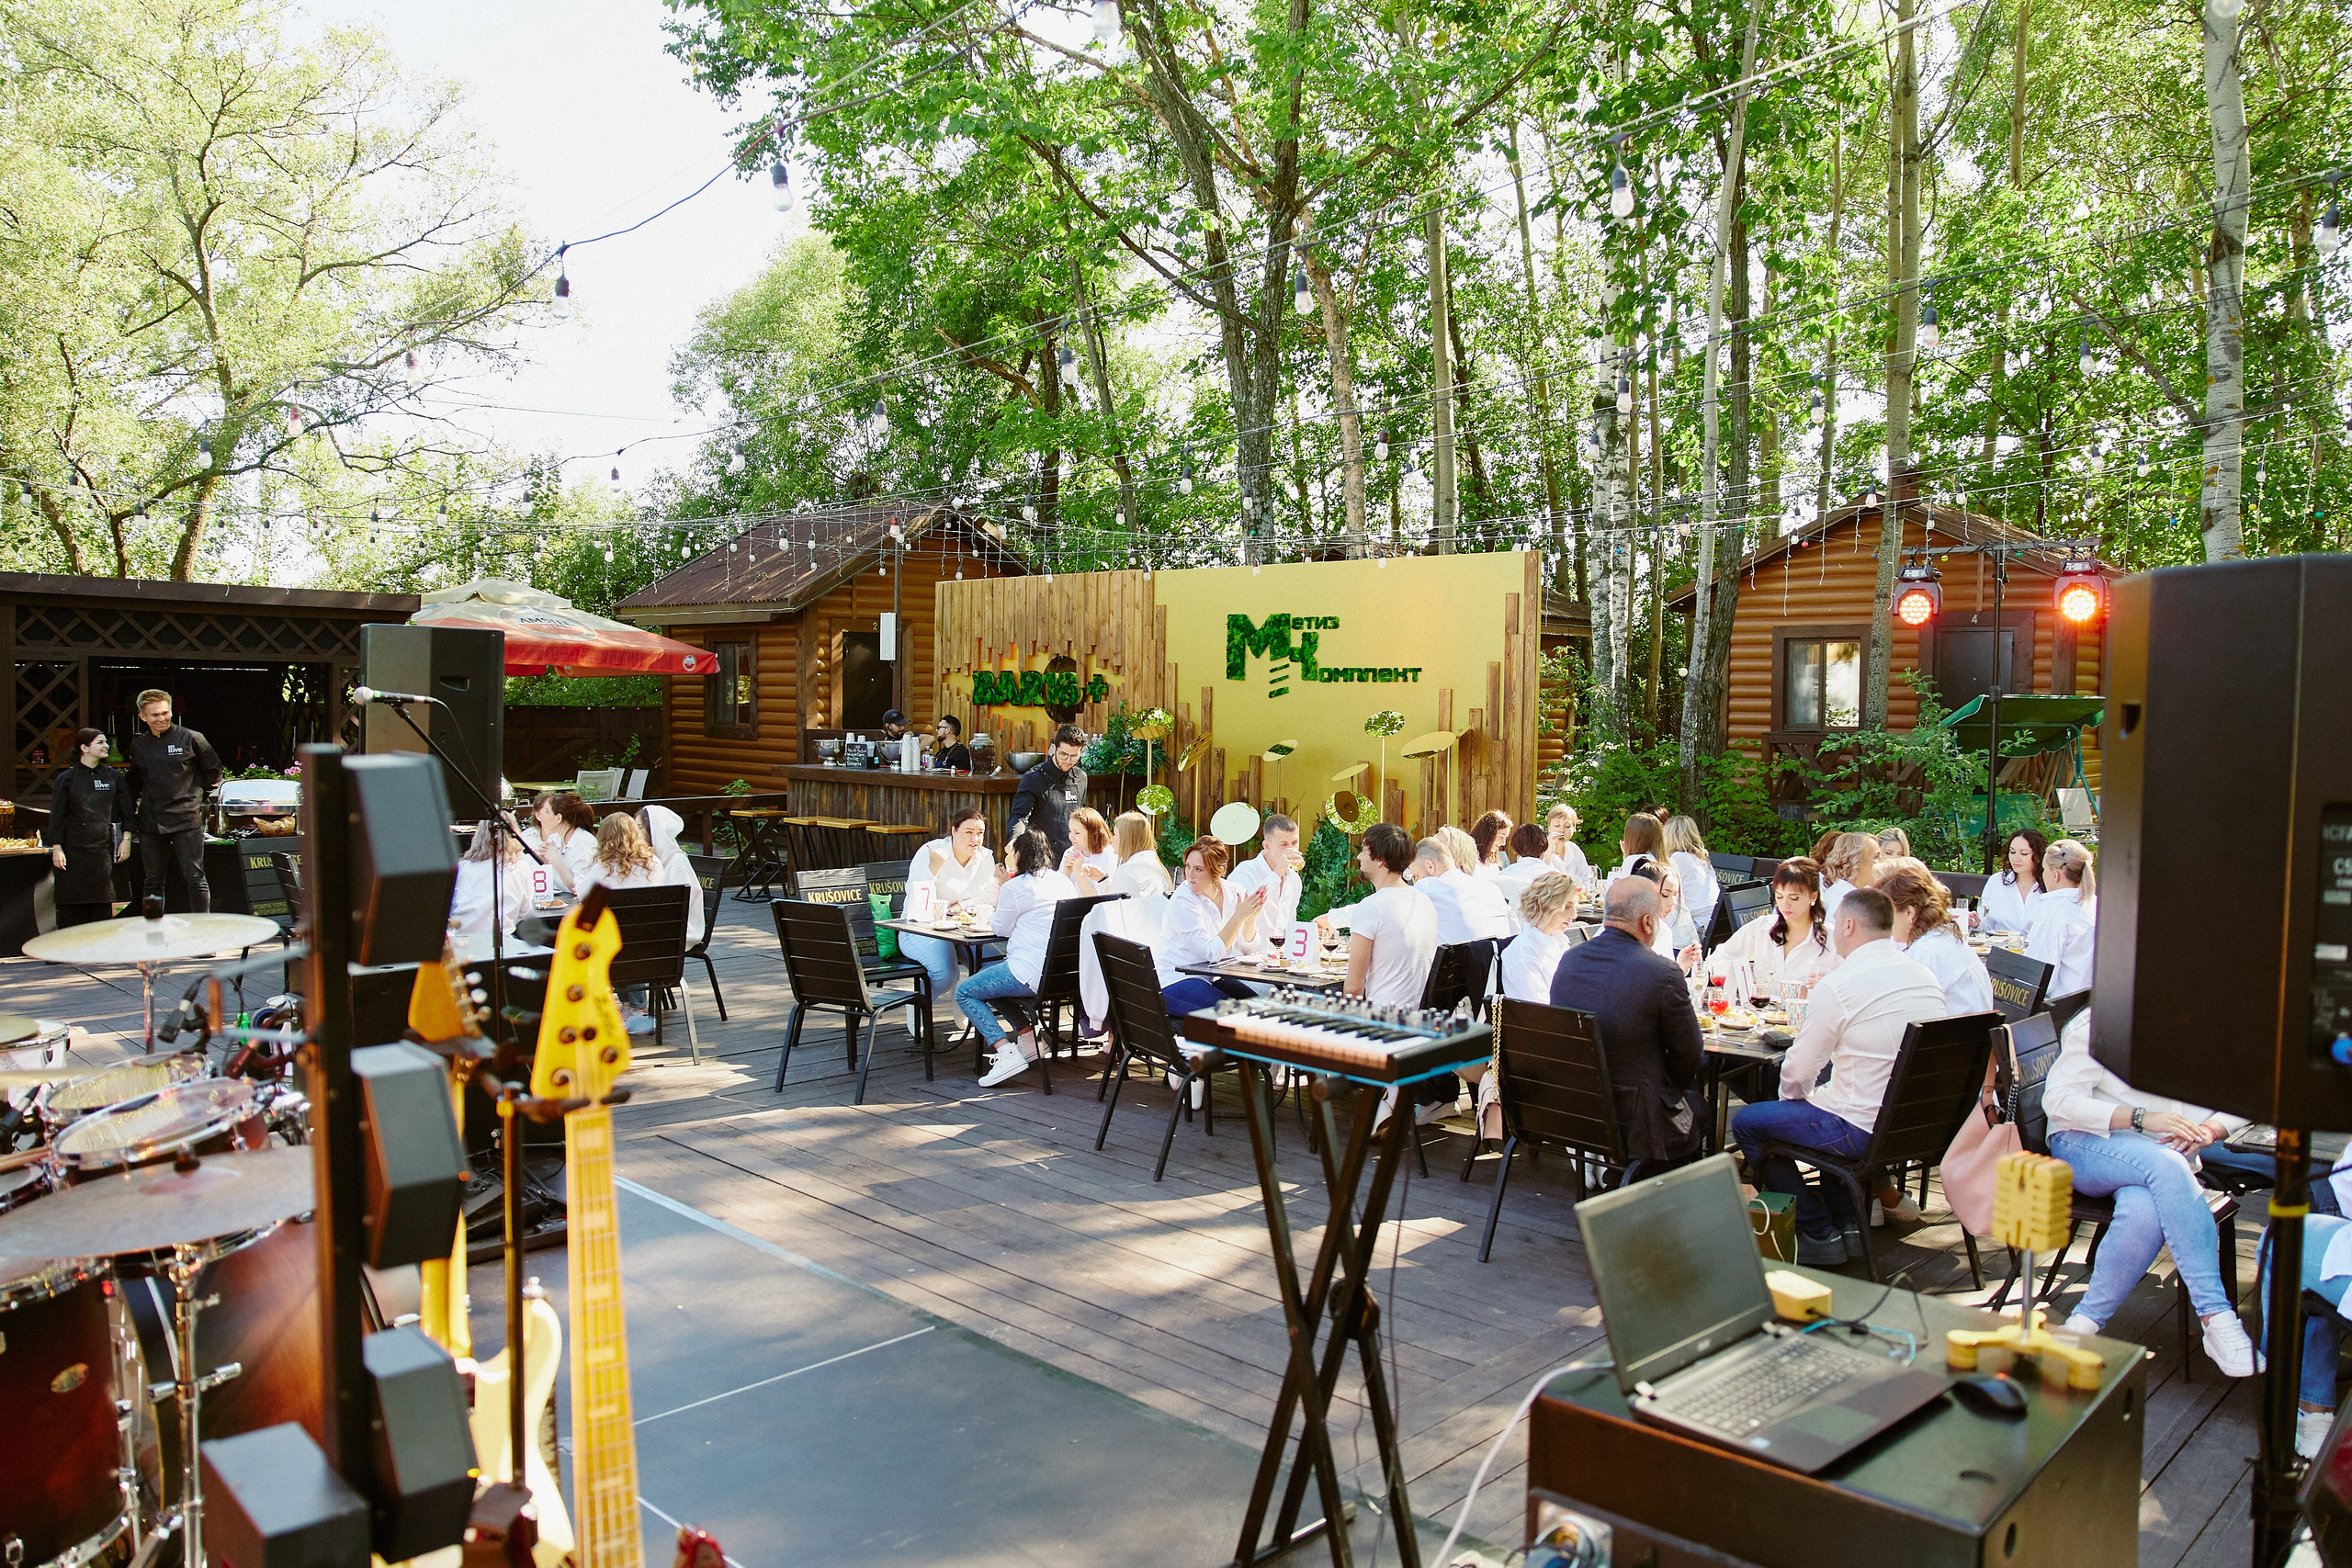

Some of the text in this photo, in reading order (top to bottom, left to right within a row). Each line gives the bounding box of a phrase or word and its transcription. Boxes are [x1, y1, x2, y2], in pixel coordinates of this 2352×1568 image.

[872, 621, 878, 631] 2
[1971, 614, 1978, 624] 4
[533, 870, 547, 893] 8
[921, 887, 930, 910] 7
[1292, 929, 1308, 957] 3
